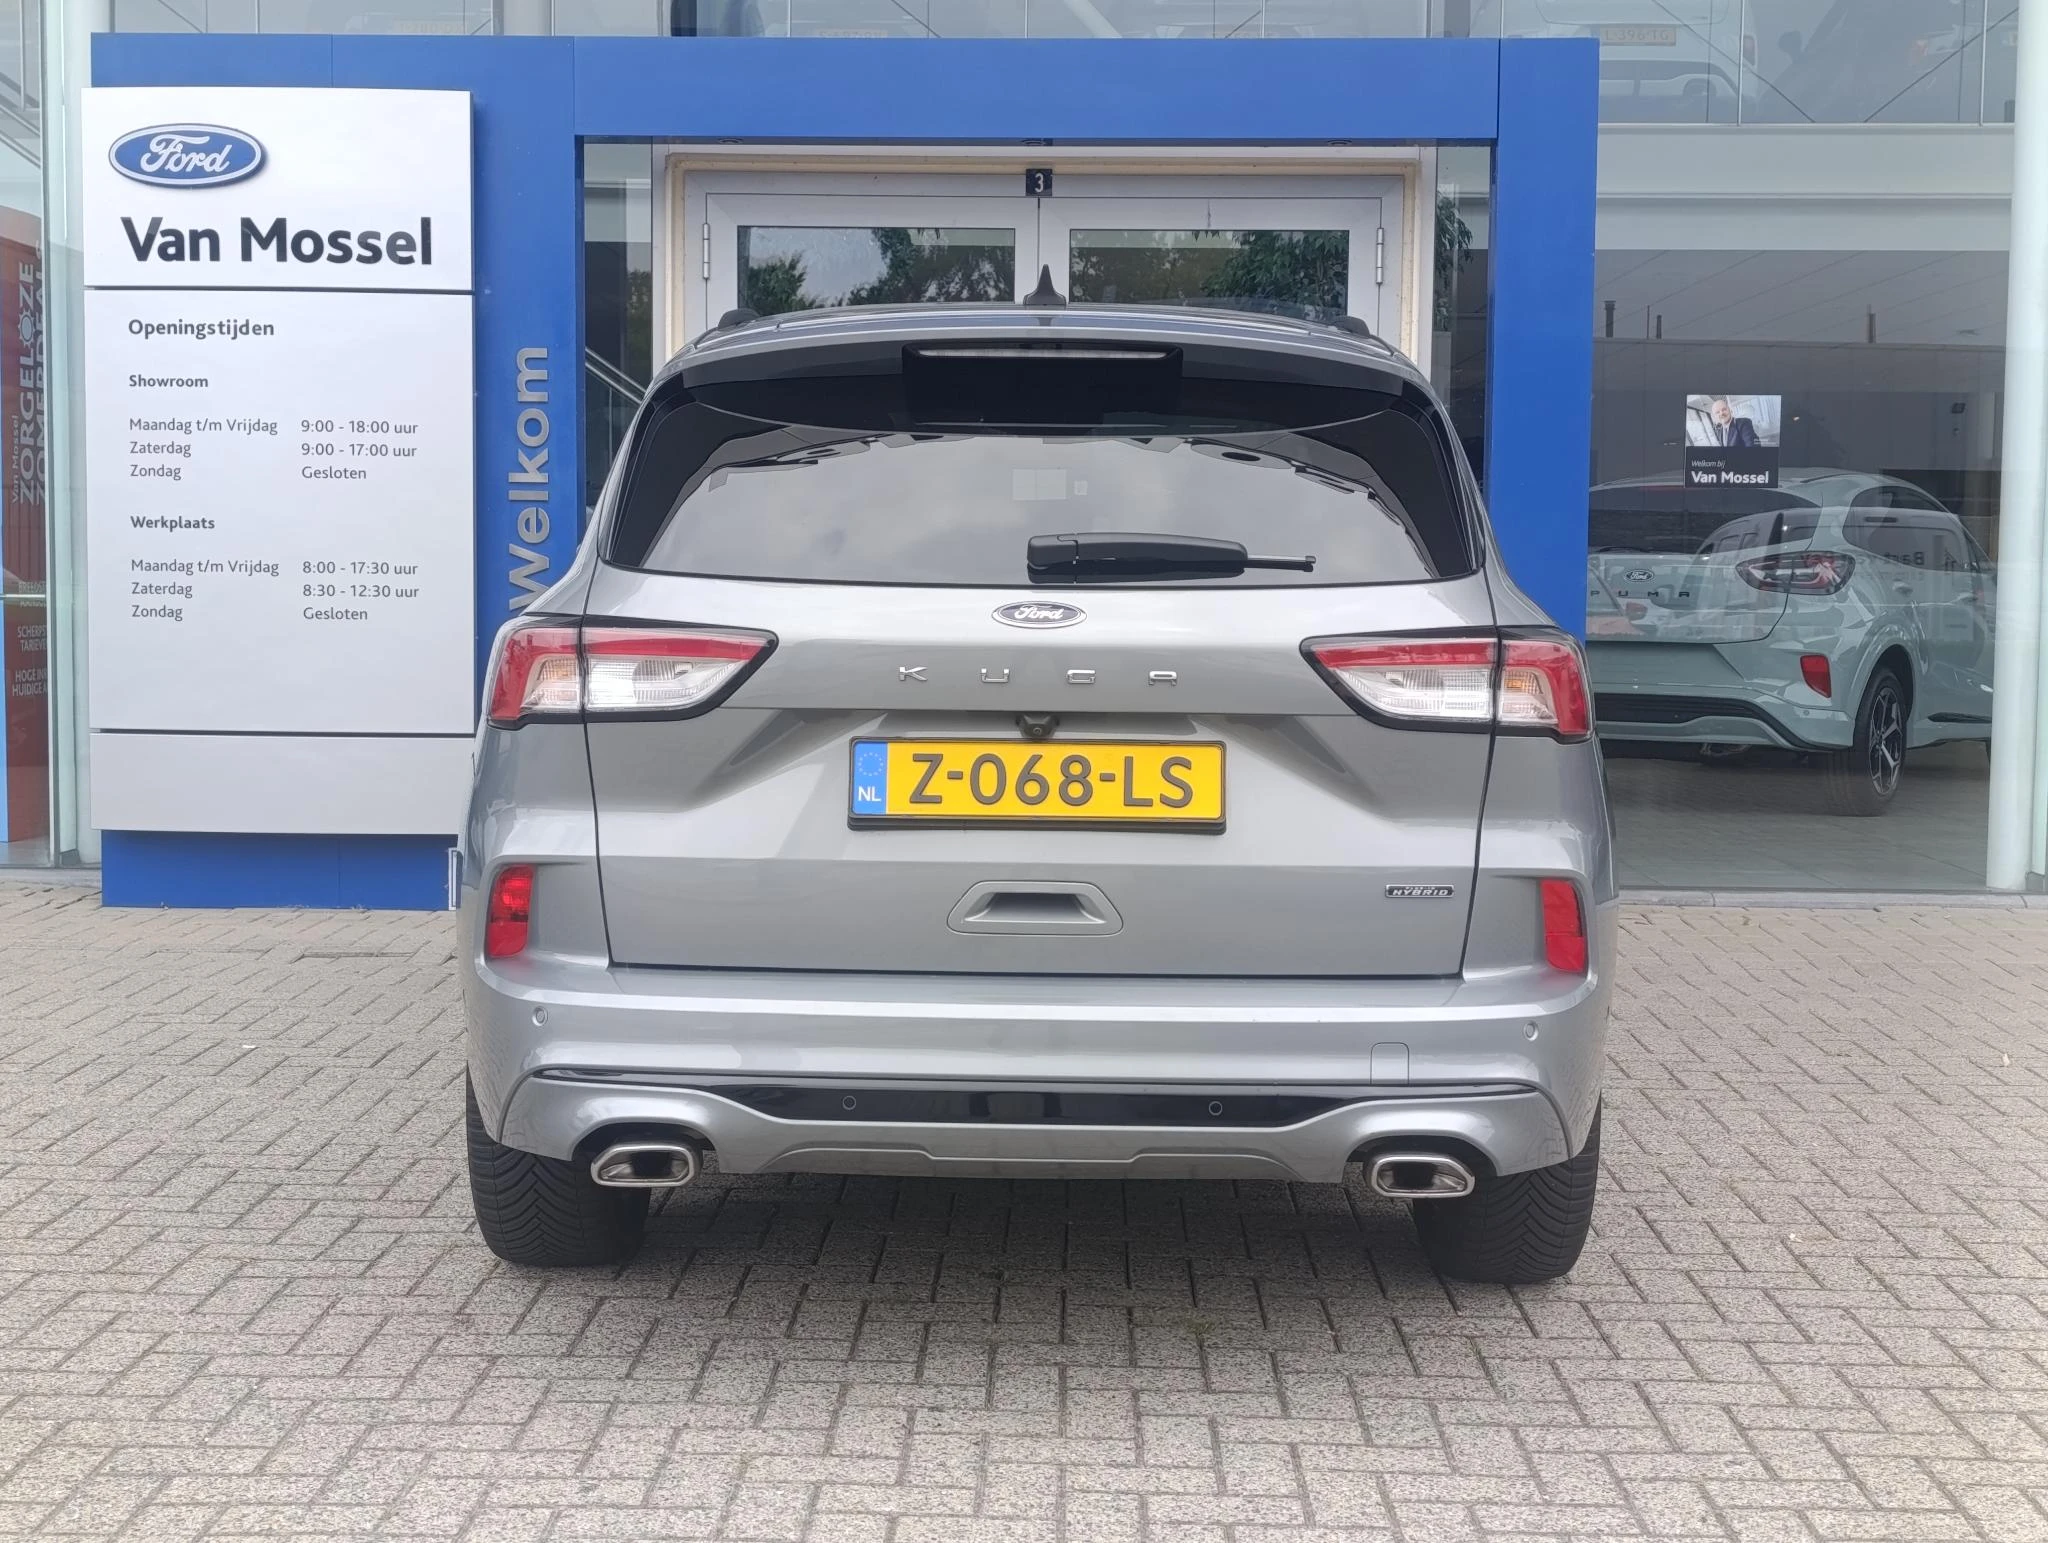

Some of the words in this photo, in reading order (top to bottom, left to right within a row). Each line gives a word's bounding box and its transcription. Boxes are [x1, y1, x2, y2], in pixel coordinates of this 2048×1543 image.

[140, 133, 232, 172] Ford
[1034, 172, 1044, 193] 3
[120, 216, 220, 262] Van
[240, 216, 432, 265] Mossel
[128, 319, 275, 340] Openingstijden
[129, 374, 209, 388] Showroom
[129, 418, 192, 435] Maandag
[196, 418, 222, 432] t/m
[226, 419, 278, 436] Vrijdag
[301, 420, 334, 433] 9:00
[349, 420, 390, 434] 18:00
[394, 423, 419, 434] uur
[129, 441, 192, 458] Zaterdag
[301, 443, 335, 456] 9:00
[349, 443, 390, 457] 17:00
[393, 447, 418, 457] uur
[130, 464, 182, 481] Zondag
[1691, 459, 1716, 467] Welkom
[1717, 459, 1726, 469] bij
[301, 466, 367, 480] Gesloten
[508, 346, 550, 611] Welkom
[1691, 471, 1717, 484] Van
[1721, 470, 1769, 484] Mossel
[130, 515, 215, 532] Werkplaats
[131, 559, 194, 576] Maandag
[198, 559, 224, 573] t/m
[228, 560, 280, 577] Vrijdag
[302, 561, 336, 574] 8:00
[350, 561, 390, 575] 17:30
[394, 565, 419, 575] uur
[131, 582, 193, 598] Zaterdag
[303, 584, 336, 597] 8:30
[350, 584, 391, 598] 12:30
[395, 588, 420, 598] uur
[1590, 590, 1690, 598] PUMA
[131, 605, 183, 622] Zondag
[303, 607, 368, 621] Gesloten
[1013, 604, 1064, 621] Ford
[899, 666, 1178, 686] KUGA
[908, 752, 1194, 809] Z-068-LS
[858, 786, 881, 802] NL
